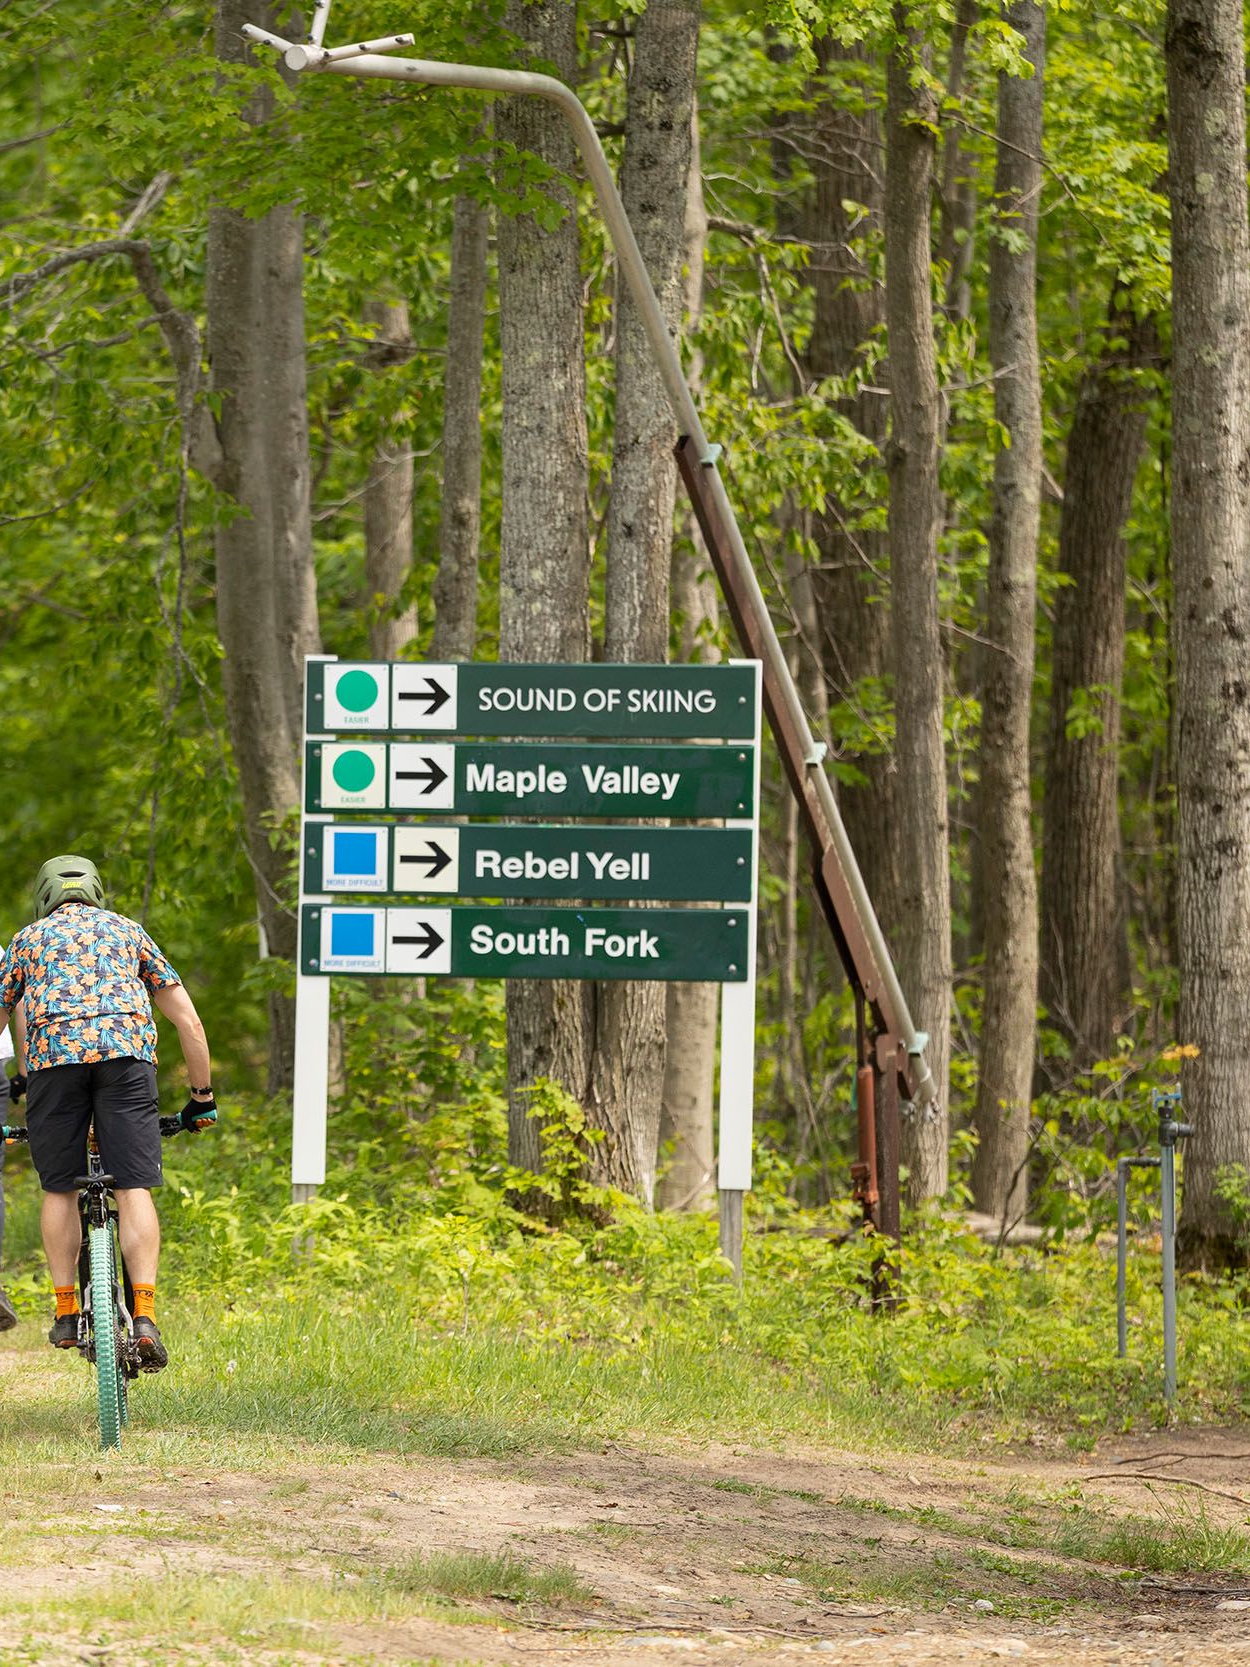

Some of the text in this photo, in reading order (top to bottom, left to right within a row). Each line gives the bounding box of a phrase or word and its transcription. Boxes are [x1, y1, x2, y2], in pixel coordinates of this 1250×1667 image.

[478, 687, 717, 714] SOUND OF SKIING
[344, 716, 370, 724] EASIER
[466, 763, 681, 800] Maple Valley
[475, 849, 650, 881] Rebel Yell
[349, 879, 384, 887] DIFFICULT
[469, 924, 660, 958] South Fork
[324, 959, 381, 968] MORE DIFFICULT
